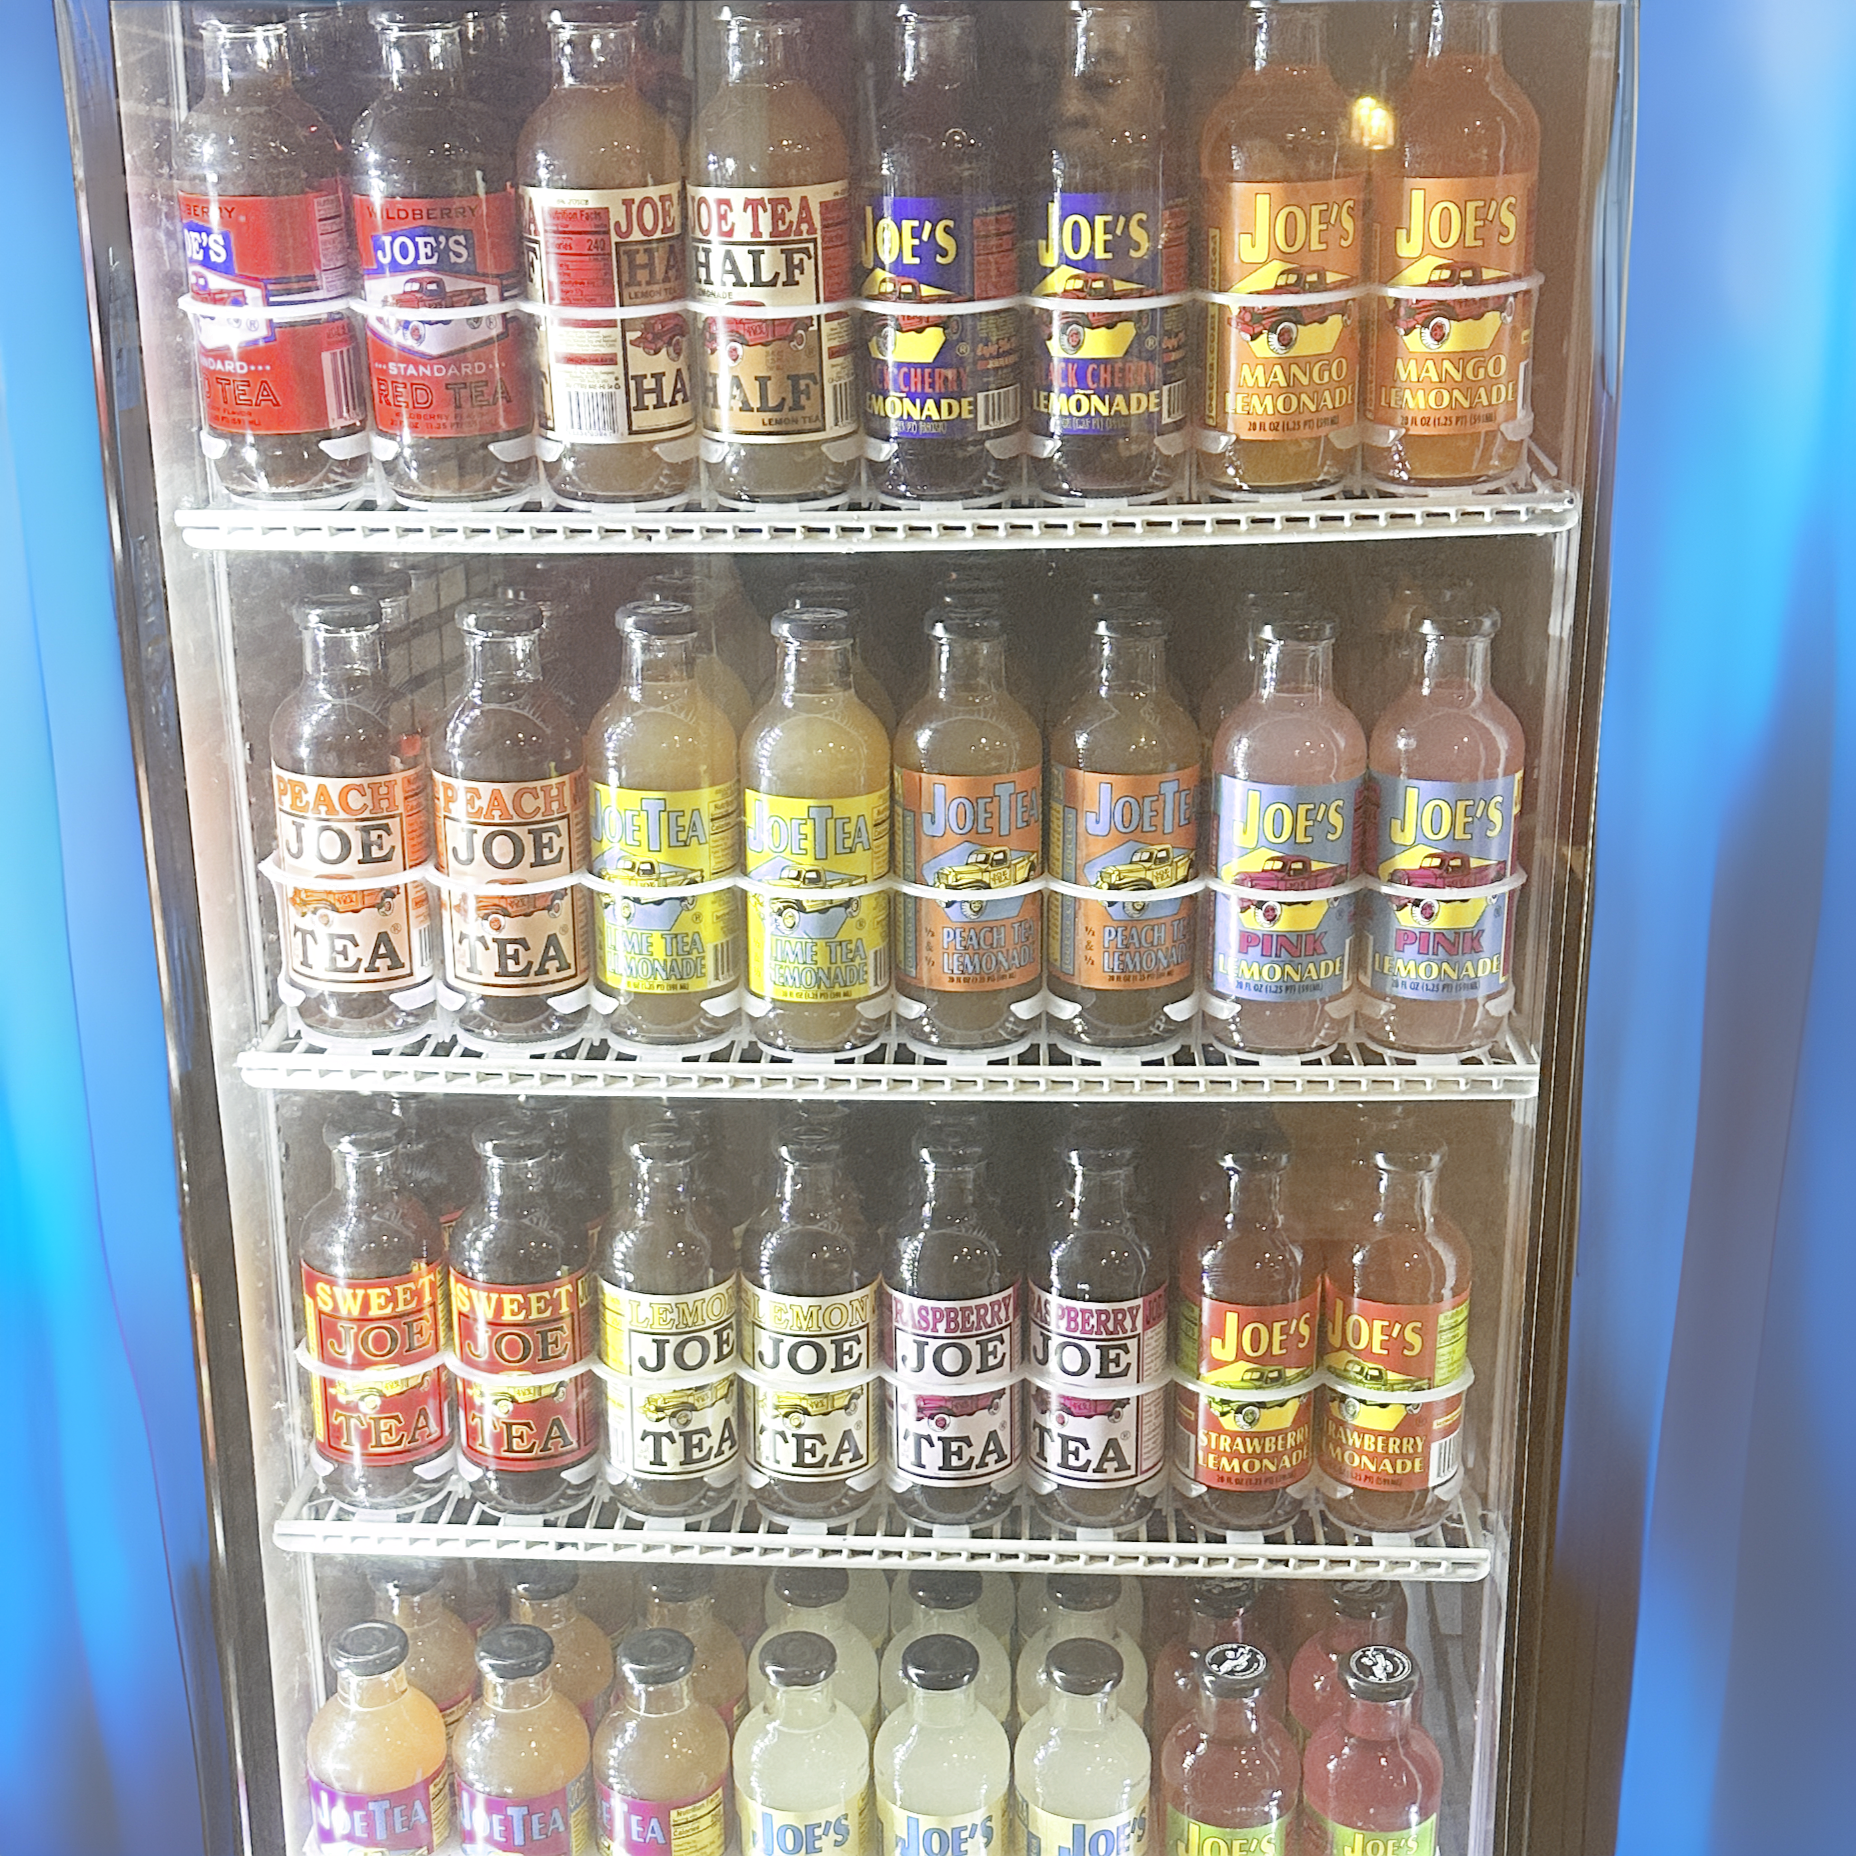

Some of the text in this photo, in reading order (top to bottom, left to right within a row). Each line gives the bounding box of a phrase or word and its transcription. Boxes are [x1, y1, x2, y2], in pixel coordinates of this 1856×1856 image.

[367, 204, 479, 221] WILDBERRY
[614, 194, 676, 239] JOE
[743, 195, 818, 238] TEA
[1238, 192, 1355, 264] JOE'S
[1395, 187, 1517, 260] JOE'S
[377, 233, 469, 265] JOE'S
[587, 238, 605, 252] 240
[861, 205, 958, 269] JOE'S
[1037, 202, 1150, 269] JOE'S
[690, 246, 813, 287] HALF
[628, 288, 661, 300] LEMON
[388, 361, 486, 377] STANDARD
[898, 366, 968, 393] CHERRY
[1086, 361, 1156, 389] CHERRY
[1238, 356, 1348, 388] MANGO
[1393, 353, 1508, 384] MANGO
[215, 376, 282, 407] TEA
[376, 377, 512, 410] RED TEA
[1032, 389, 1161, 417] LEMONADE
[1224, 382, 1355, 416] LEMONADE
[1380, 380, 1516, 410] LEMONADE
[761, 415, 821, 426] LEMON TEA
[1248, 421, 1257, 432] 20
[1258, 421, 1267, 432] FL
[1269, 420, 1280, 432] OZ
[1420, 415, 1431, 427] OZ
[276, 774, 399, 816] PEACH
[441, 781, 568, 820] PEACH
[1232, 788, 1346, 850] JOE'S
[1390, 785, 1505, 847] JOE'S
[285, 820, 396, 865] JOE
[452, 825, 564, 870] JOE
[292, 925, 405, 973] TEA
[459, 931, 571, 978] TEA
[606, 925, 705, 957] LIME TEA
[826, 938, 867, 964] TEA
[925, 941, 934, 952] &
[942, 924, 1006, 951] PEACH
[1084, 940, 1094, 952] &
[1103, 922, 1166, 949] PEACH
[1238, 929, 1328, 958] PINK
[1395, 927, 1485, 957] PINK
[1218, 953, 1344, 983] LEMONADE
[1374, 952, 1501, 981] LEMONADE
[1409, 981, 1420, 991] OZ
[1253, 983, 1263, 992] OZ
[316, 1274, 436, 1317] SWEET
[456, 1283, 574, 1321] SWEET
[752, 1292, 869, 1332] LEMON
[893, 1292, 1012, 1334] RASPBERRY
[327, 1313, 436, 1359] JOE
[466, 1323, 570, 1366] JOE
[637, 1321, 736, 1373] JOE
[1210, 1310, 1311, 1362] JOE'S
[1328, 1298, 1424, 1357] JOE'S
[757, 1333, 863, 1375] JOE
[901, 1335, 1006, 1378] JOE
[1032, 1331, 1132, 1379] JOE
[334, 1405, 438, 1450] TEA
[470, 1415, 577, 1456] TEA
[639, 1416, 738, 1467] TEA
[759, 1424, 864, 1469] TEA
[903, 1428, 1008, 1472] TEA
[1032, 1421, 1132, 1474] TEA
[1197, 1442, 1310, 1474] LEMONADE
[752, 1812, 850, 1856] JOE'S
[896, 1814, 994, 1856] JOE'S
[1058, 1806, 1147, 1856] JOE'S
[1177, 1821, 1277, 1856] JOE'S
[1344, 1832, 1418, 1856] JOE'S
